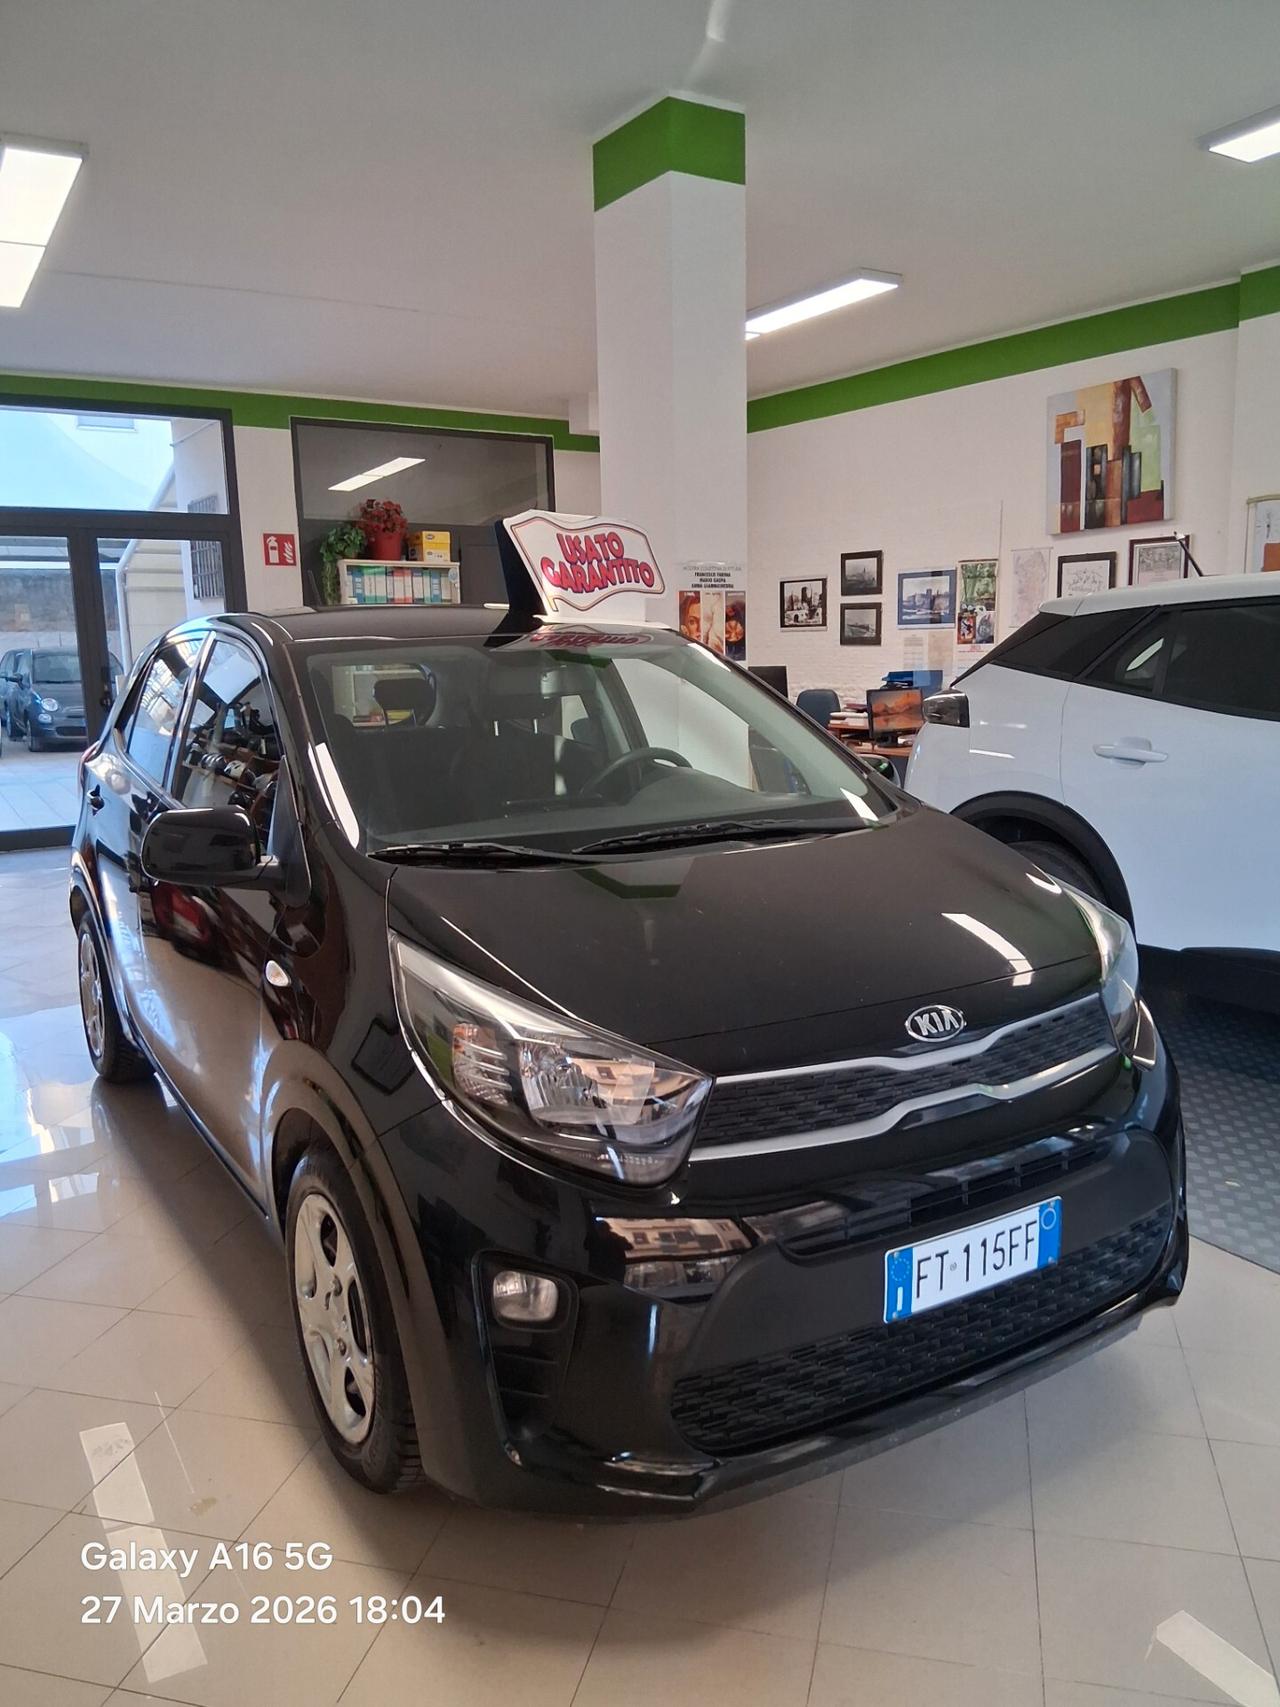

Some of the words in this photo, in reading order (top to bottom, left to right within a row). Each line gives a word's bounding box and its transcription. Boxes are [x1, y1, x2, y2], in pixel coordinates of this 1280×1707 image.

[556, 531, 624, 566] USATO
[540, 556, 655, 594] GARANTITO
[914, 1008, 960, 1036] KIA
[916, 1250, 949, 1299] FT
[963, 1220, 1038, 1282] 115FF
